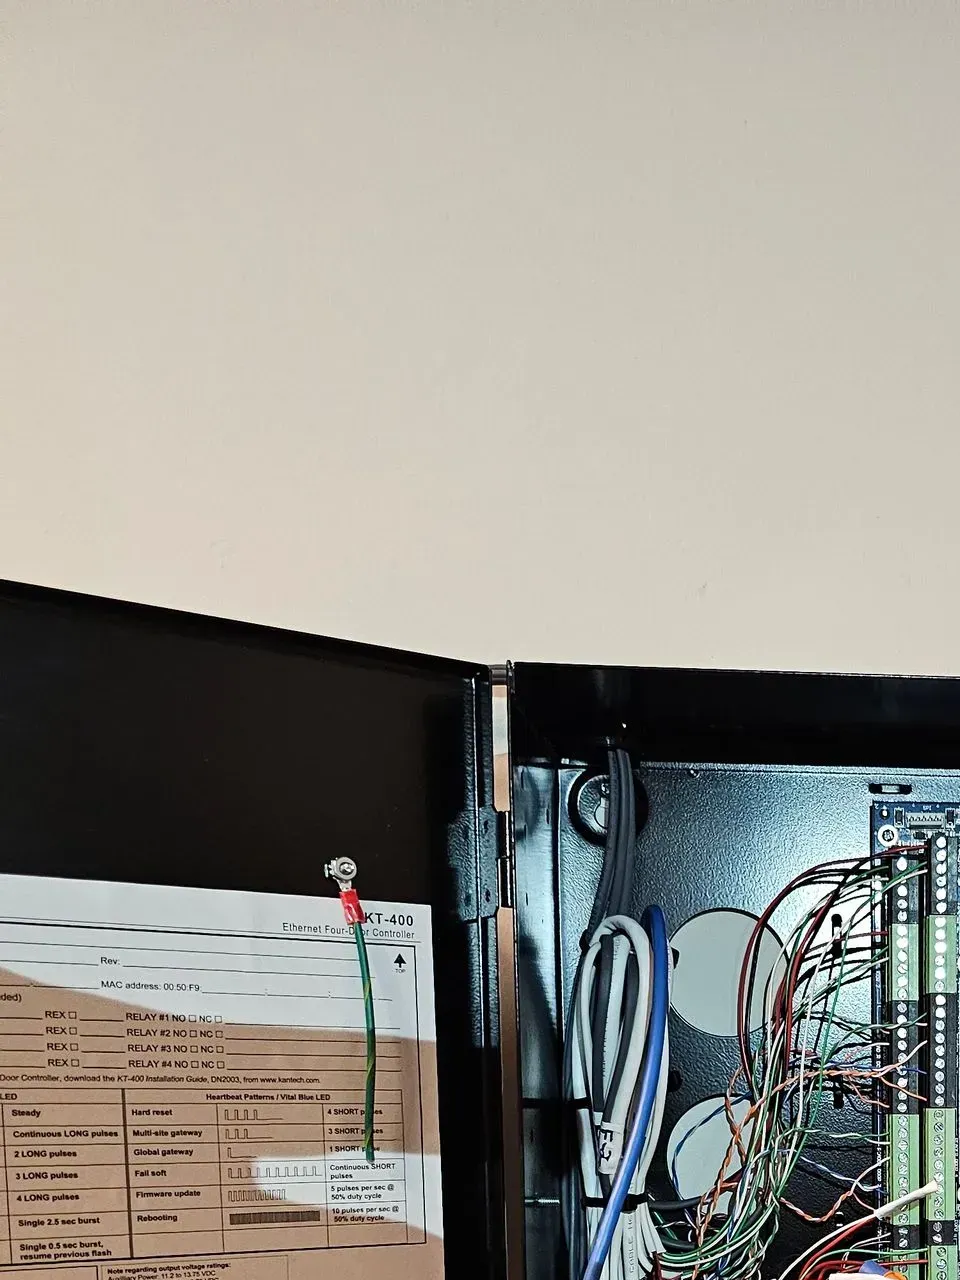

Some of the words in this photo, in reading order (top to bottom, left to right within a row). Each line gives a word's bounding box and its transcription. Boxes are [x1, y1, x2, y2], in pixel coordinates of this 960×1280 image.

[364, 913, 414, 926] KT-400
[283, 923, 322, 933] Ethernet
[325, 926, 370, 936] Four-Dor
[373, 929, 415, 939] Controller
[101, 957, 120, 965] Rev:
[101, 981, 123, 989] MAC
[125, 982, 161, 990] address:
[45, 1011, 66, 1019] REX
[126, 1013, 157, 1021] RELAY
[172, 1014, 186, 1022] NO
[199, 1015, 212, 1023] NC
[127, 1029, 158, 1037] RELAY
[128, 1060, 159, 1068] RELAY
[146, 1075, 184, 1083] Installation
[12, 1109, 41, 1118] Steady
[13, 1130, 62, 1138] Continuous
[64, 1130, 89, 1138] LONG
[91, 1130, 118, 1138] pulses
[133, 1129, 169, 1137] Multi-site
[171, 1129, 202, 1138] gateway
[21, 1150, 47, 1158] LONG
[49, 1150, 77, 1159] pulses
[162, 1148, 193, 1157] gateway
[51, 1172, 78, 1180] pulses
[151, 1169, 167, 1177] soft
[52, 1193, 80, 1202] pulses
[174, 1190, 201, 1198] update
[364, 1192, 382, 1200] cycle
[137, 1214, 178, 1222] Rebooting
[18, 1219, 45, 1227] Single
[20, 1243, 46, 1252] Single
[80, 1241, 104, 1249] burst,
[20, 1252, 52, 1260] resume
[54, 1251, 89, 1259] previous
[91, 1249, 112, 1257] flash
[107, 1267, 123, 1275] Note
[125, 1266, 157, 1275] regarding
[159, 1265, 180, 1273] output
[182, 1263, 206, 1272] voltage
